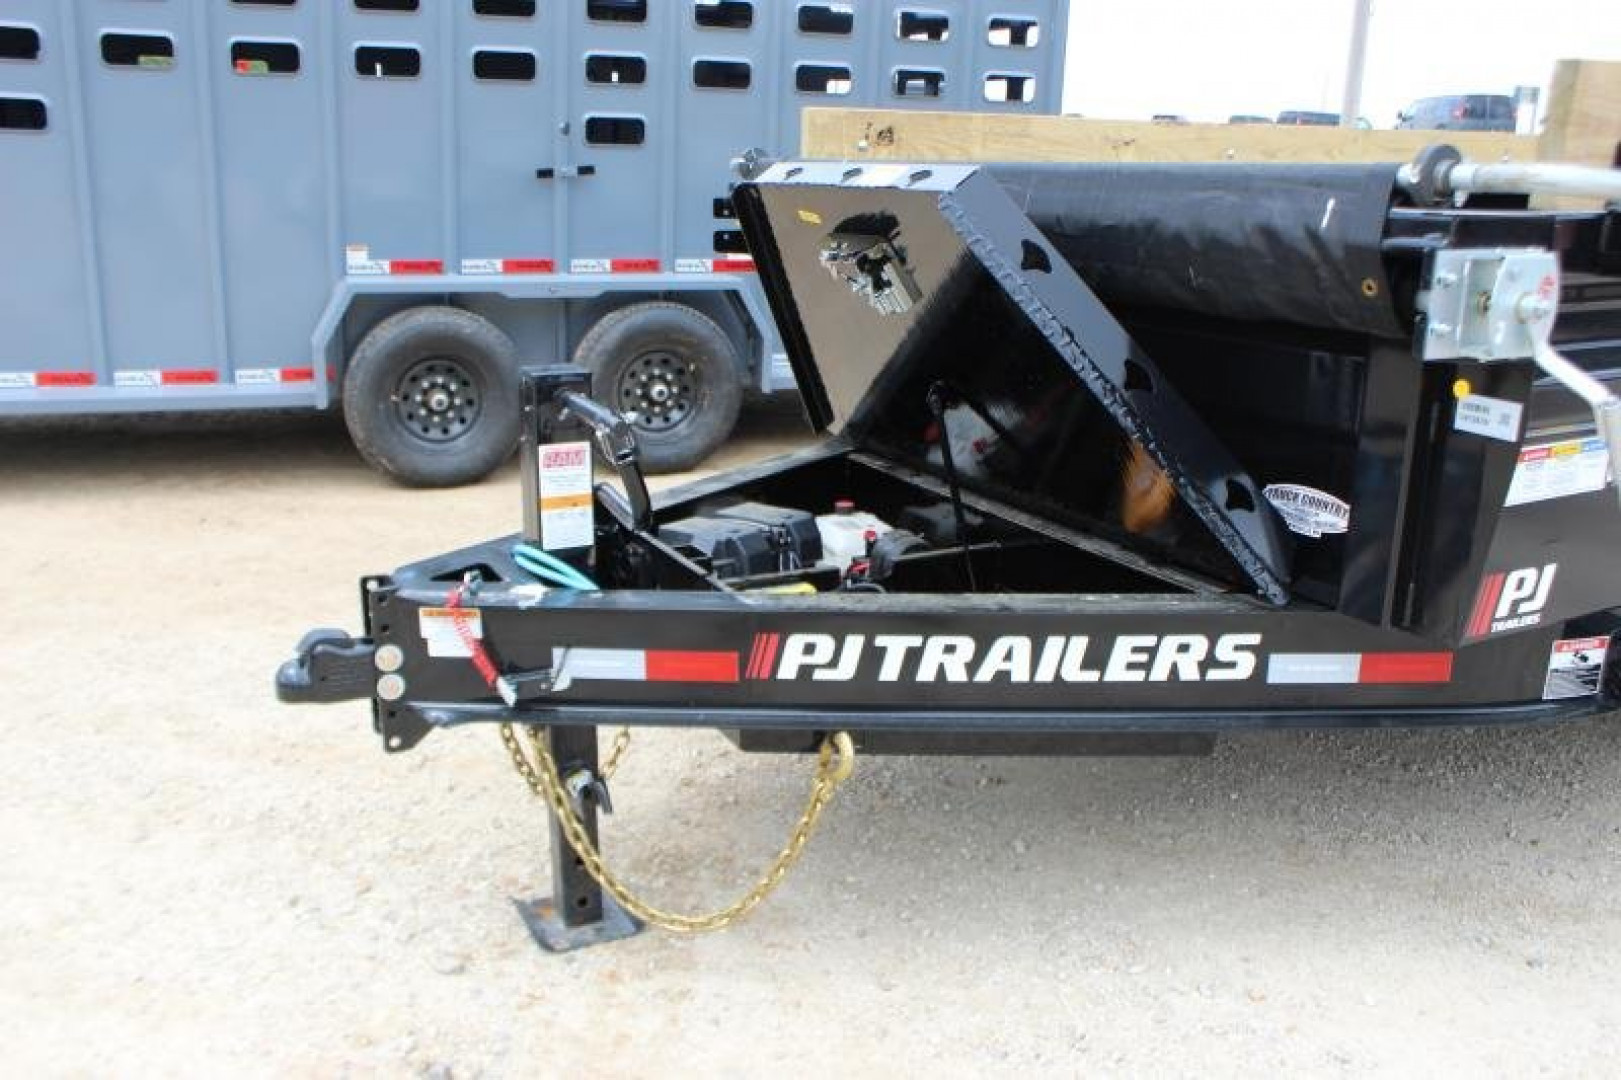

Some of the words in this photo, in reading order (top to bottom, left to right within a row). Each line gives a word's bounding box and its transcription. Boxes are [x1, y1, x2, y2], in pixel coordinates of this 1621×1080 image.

[1265, 487, 1299, 502] TRUCK
[1300, 493, 1349, 520] COUNTRY
[1495, 563, 1557, 618] PJ
[776, 633, 865, 681] PJ
[875, 633, 1262, 683] TRAILERS
